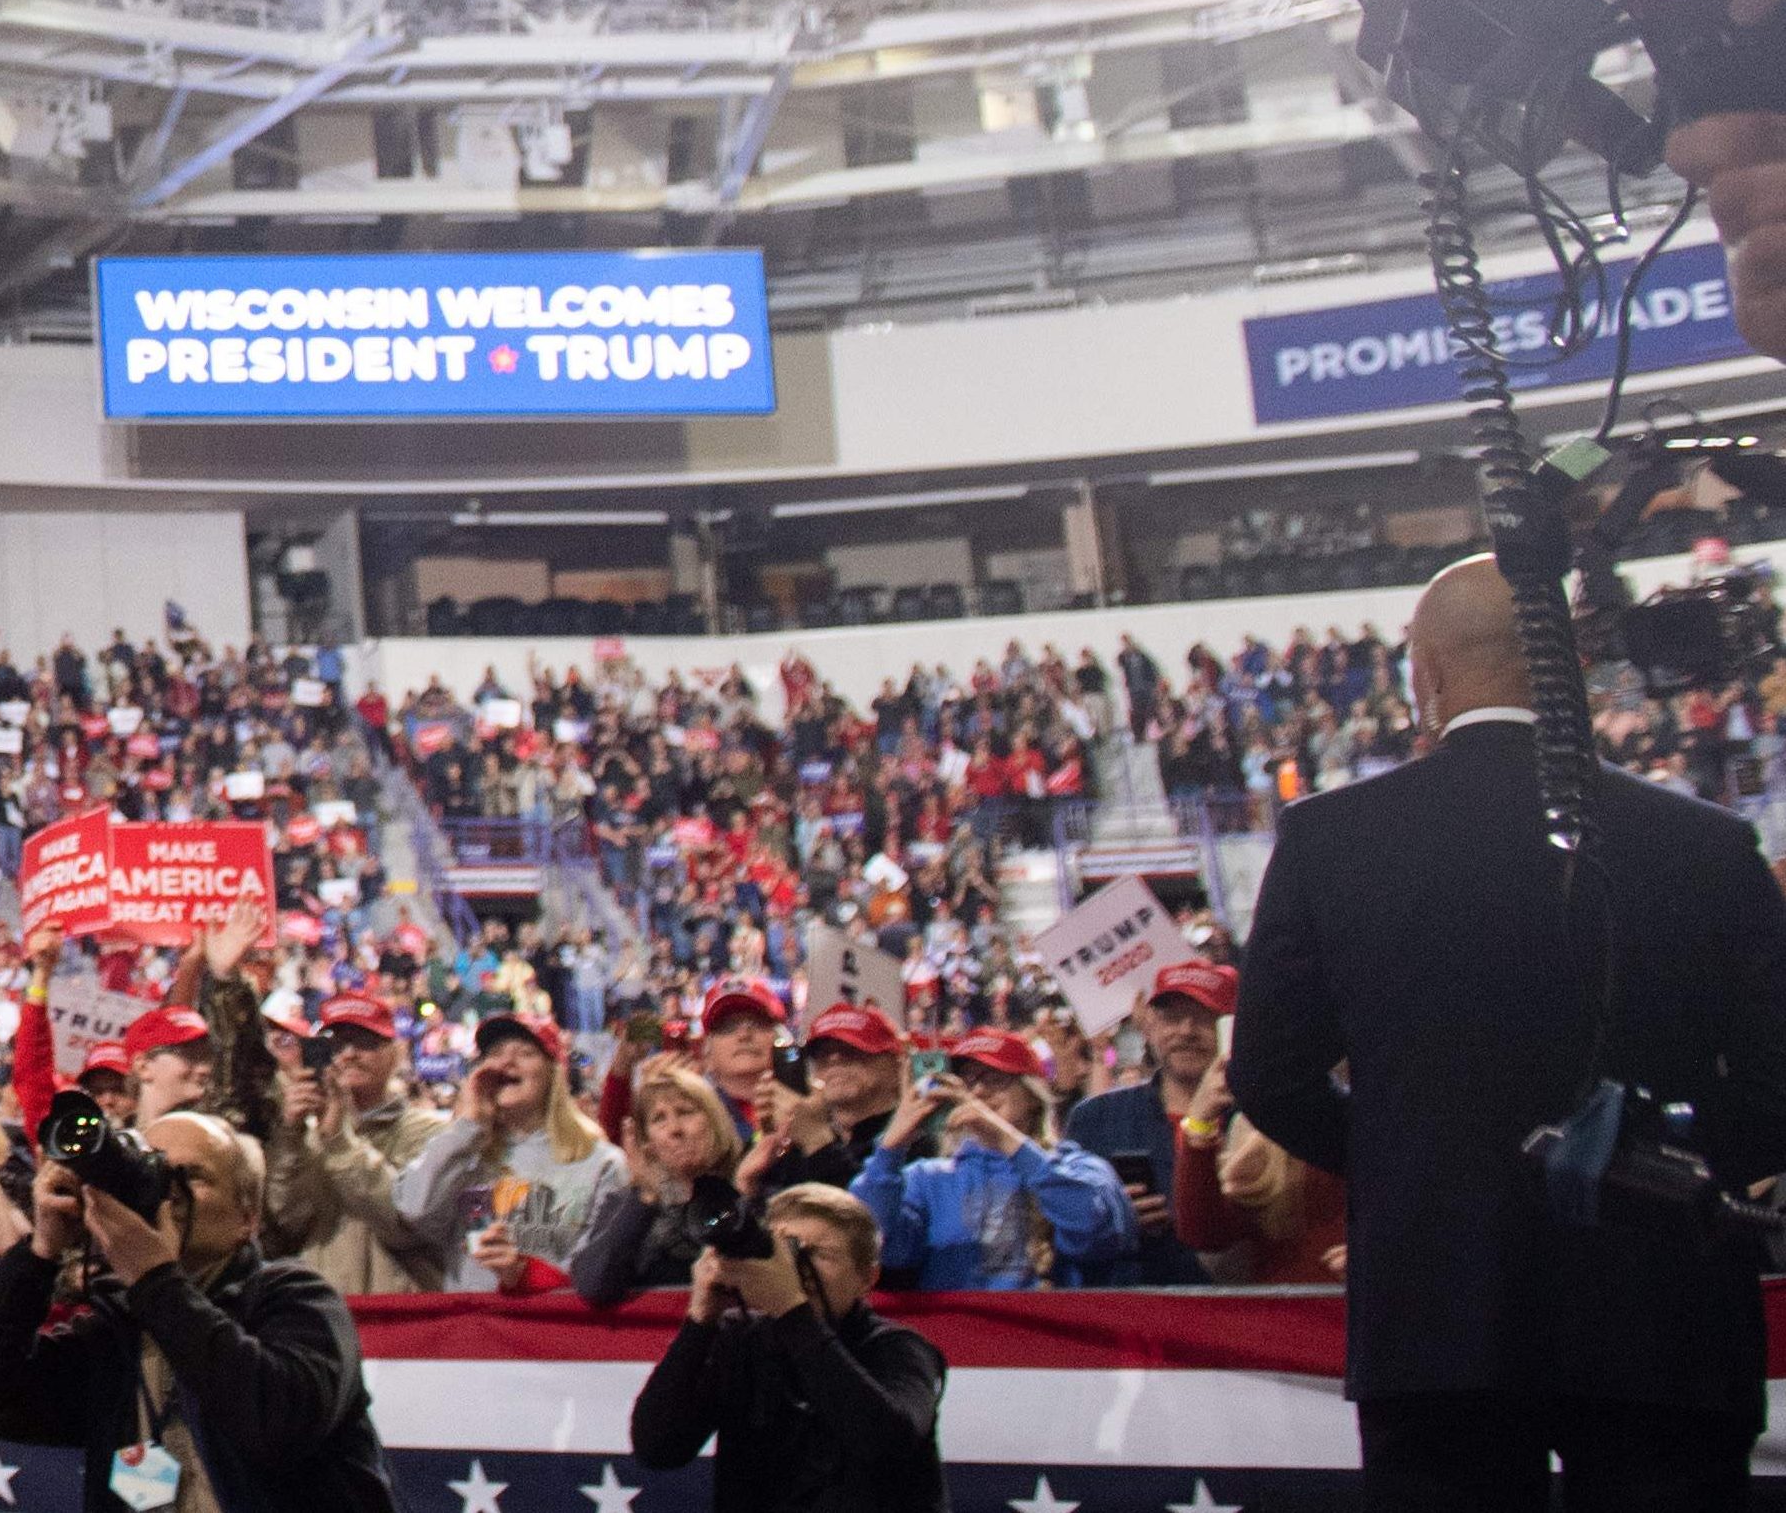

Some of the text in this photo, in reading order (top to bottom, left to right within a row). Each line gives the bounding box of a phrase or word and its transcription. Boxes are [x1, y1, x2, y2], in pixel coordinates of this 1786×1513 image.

[133, 284, 735, 331] WISCONSIN WELCOMES
[1563, 278, 1728, 344] MADE
[126, 333, 752, 384] PRESIDENT TRUMP
[147, 841, 218, 863] MAKE
[109, 866, 265, 897] AMERICA
[1058, 907, 1154, 976] TRUMP
[53, 1006, 128, 1039] TRU
